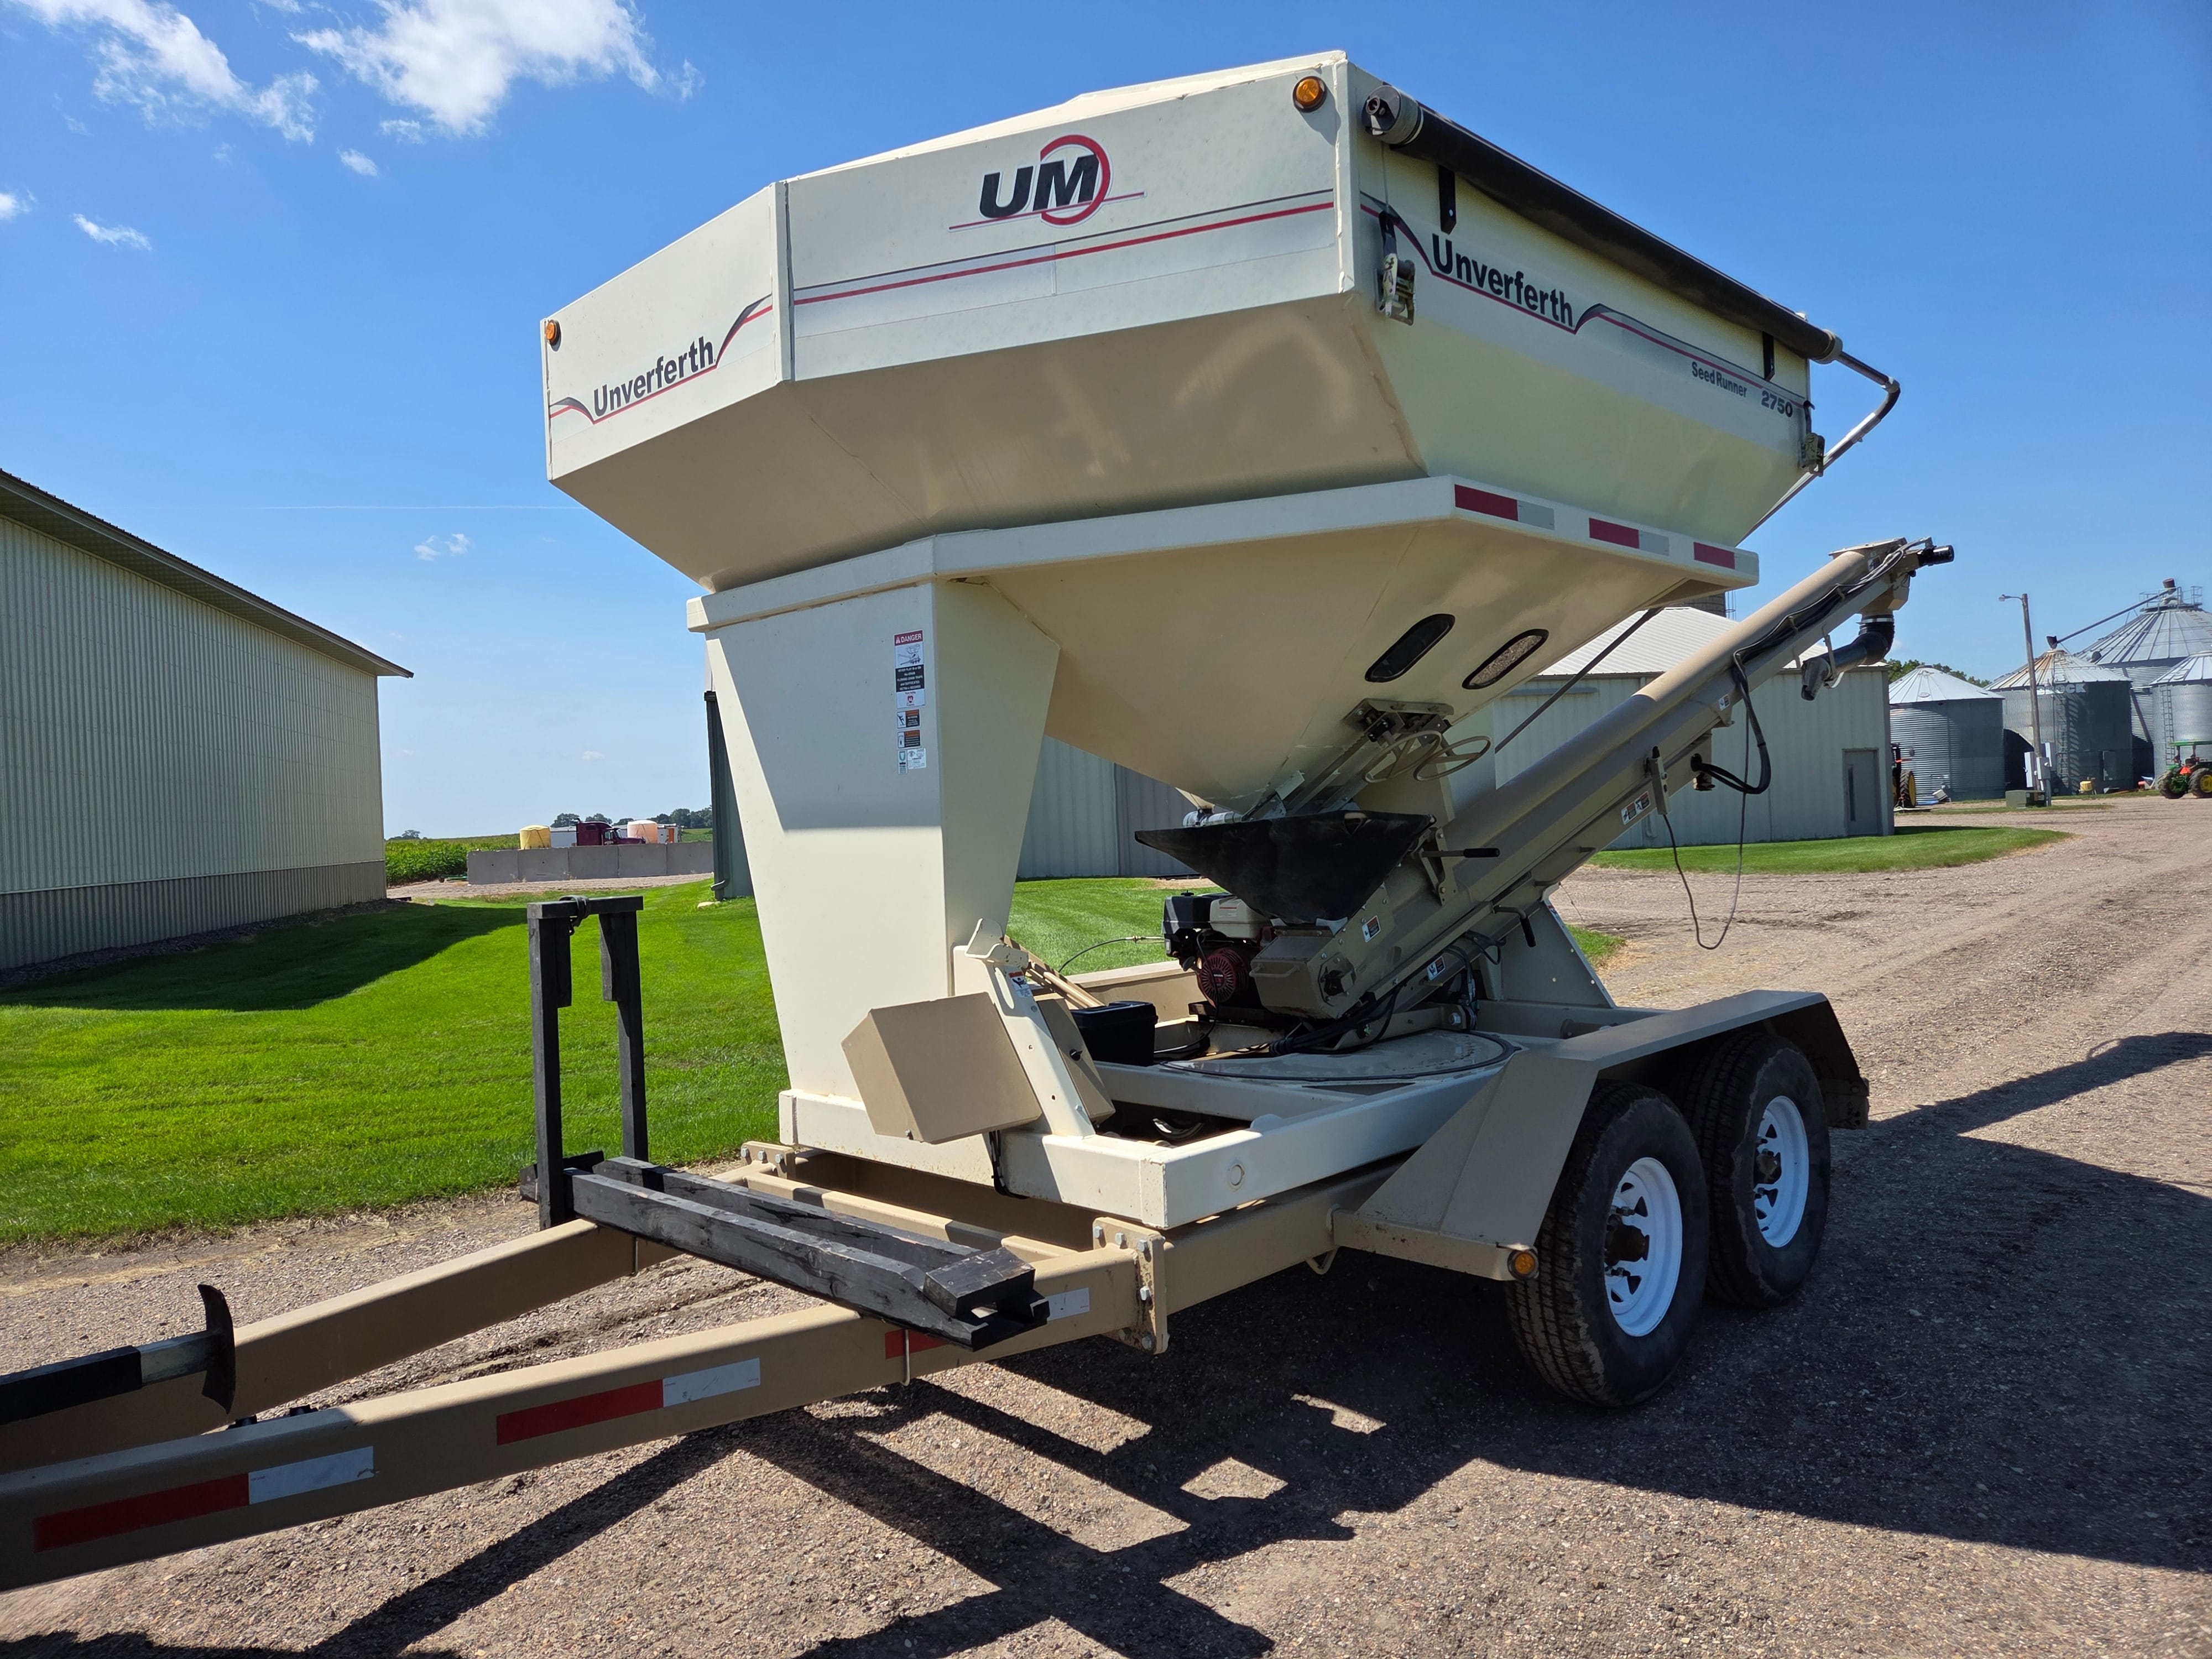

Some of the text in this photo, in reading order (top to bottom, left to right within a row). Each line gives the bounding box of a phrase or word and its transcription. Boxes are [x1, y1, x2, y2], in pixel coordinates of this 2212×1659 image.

[979, 154, 1100, 218] UM
[1432, 233, 1573, 327] Unverferth
[593, 336, 713, 417] Unverferth
[1761, 390, 1793, 418] 2750
[901, 633, 922, 643] DANGER
